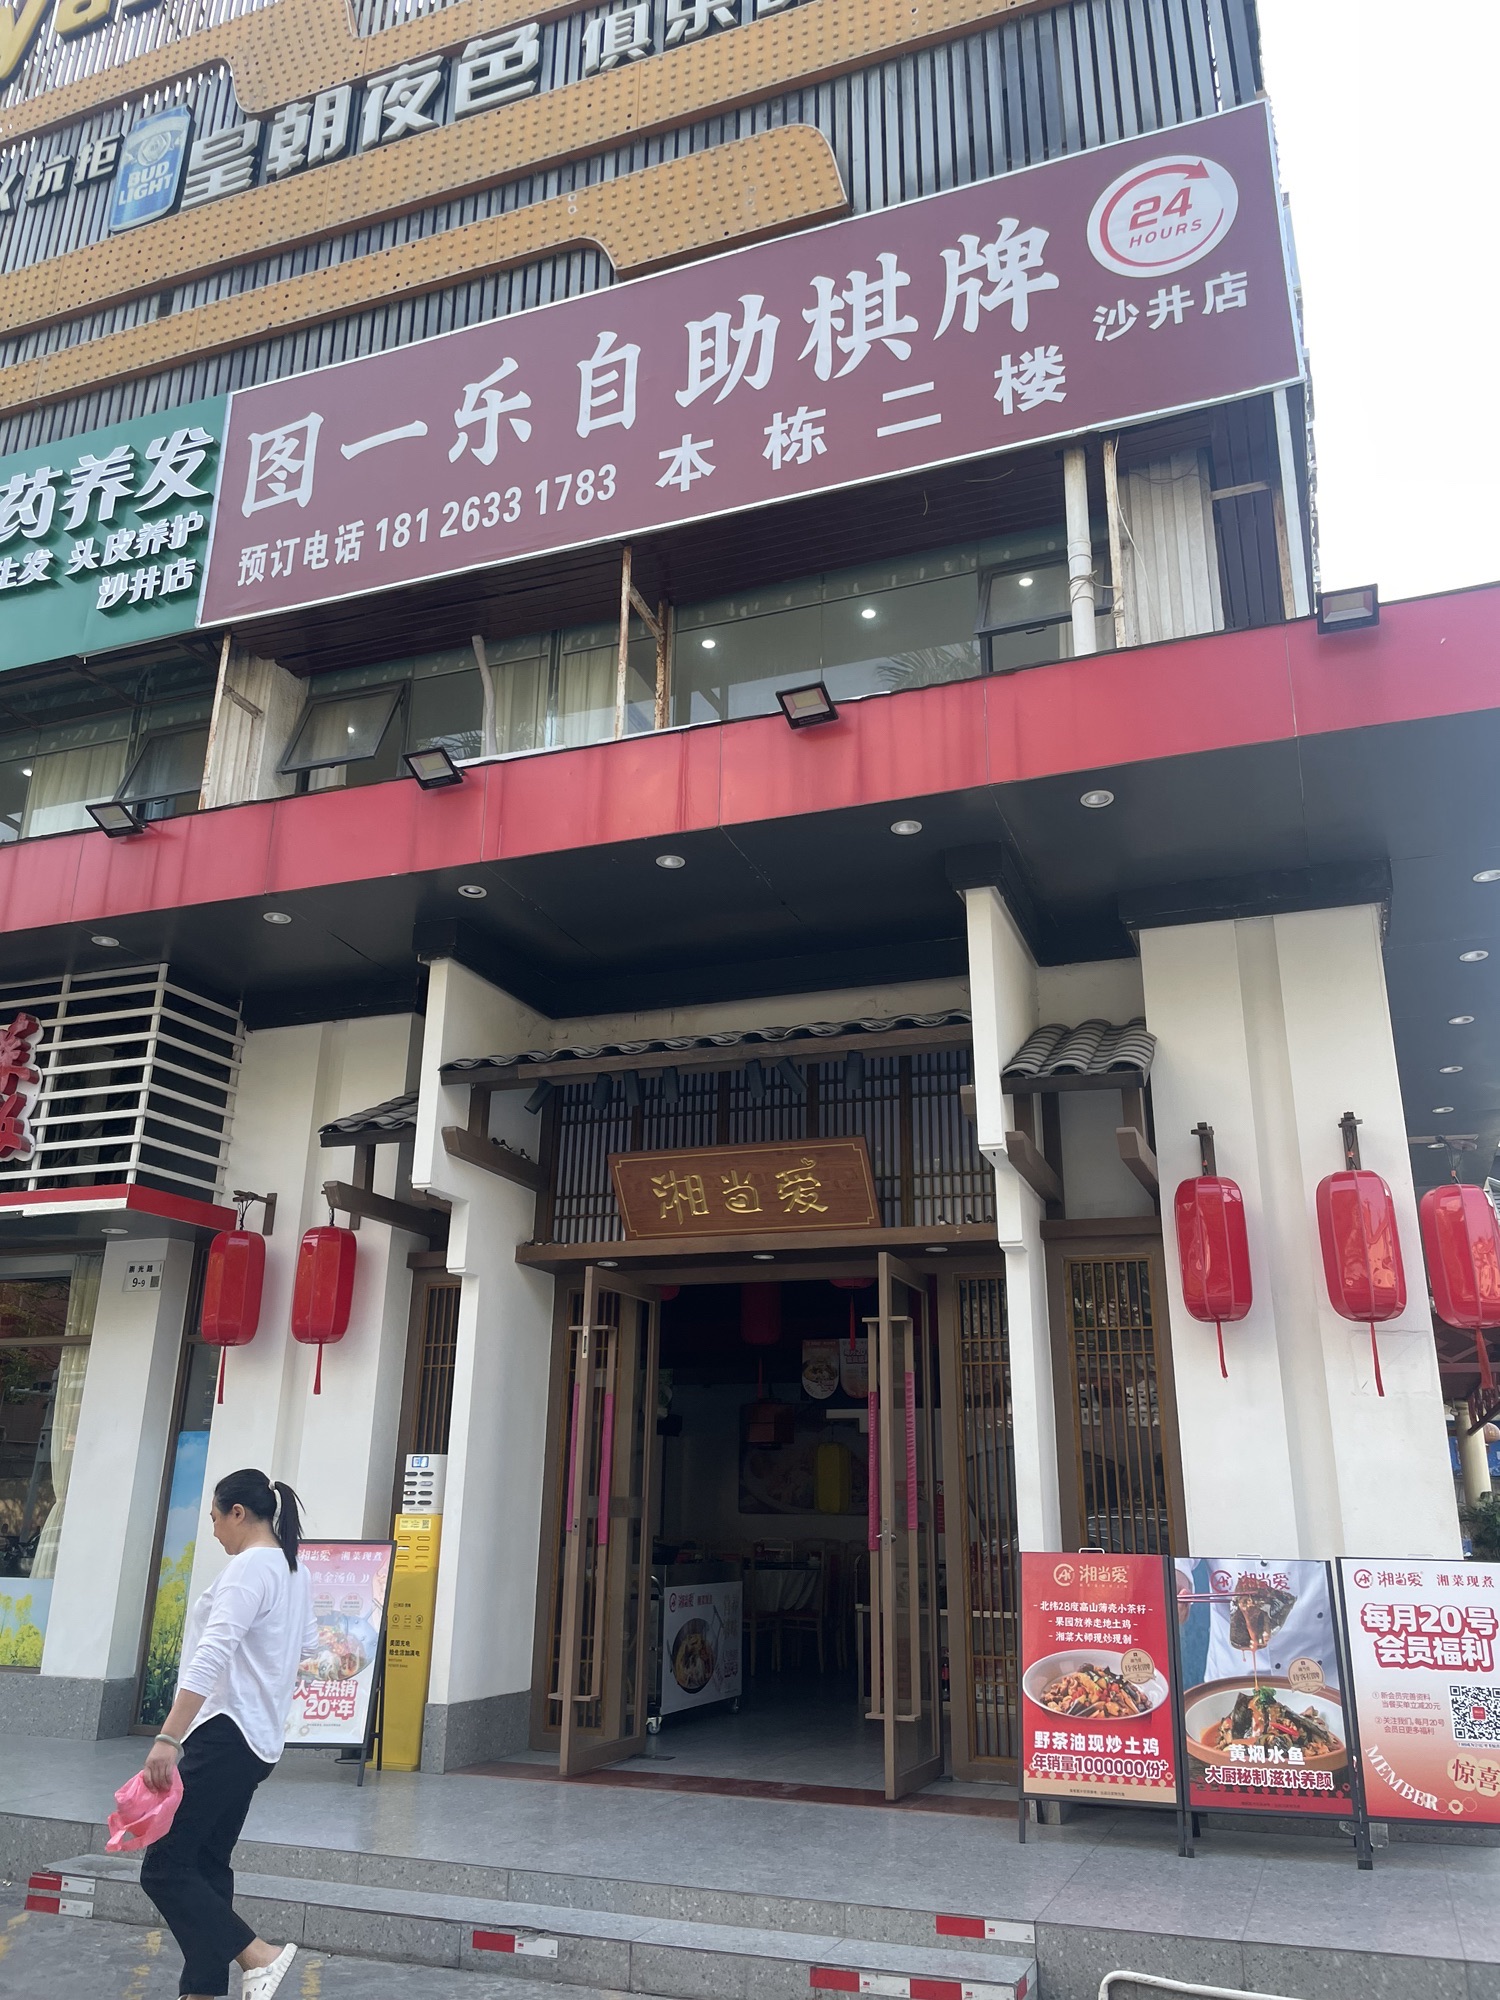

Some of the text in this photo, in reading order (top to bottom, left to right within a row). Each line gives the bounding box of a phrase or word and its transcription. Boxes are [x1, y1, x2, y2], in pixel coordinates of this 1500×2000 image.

[118, 172, 174, 206] LIGHT
[128, 161, 170, 188] BUD
[1128, 186, 1193, 231] 24
[1128, 218, 1203, 249] HOURS
[1092, 271, 1248, 342] 沙井店
[240, 217, 1060, 519] 图一乐自助棋牌
[237, 463, 618, 587] 预订电话 181 2633 1783
[65, 510, 204, 576] 头皮养护
[96, 557, 196, 610] 沙井店
[650, 1157, 829, 1225] 湘当爱
[132, 1277, 146, 1288] 9-9
[1079, 1564, 1128, 1584] 湘当爱
[1377, 1570, 1423, 1588] 湘当爱
[1436, 1574, 1495, 1588] 湘菜现煮
[1362, 1603, 1497, 1638] 每月20号
[1375, 1634, 1493, 1669] 会员福利
[293, 1680, 358, 1699] 人气热销
[304, 1699, 354, 1719] 20+年
[1034, 1731, 1159, 1756] 野茶油现炒土鸡
[1230, 1743, 1305, 1765] 黄焖水鱼
[1365, 1744, 1438, 1811] MEMBER
[1452, 1758, 1500, 1791] 惊喜
